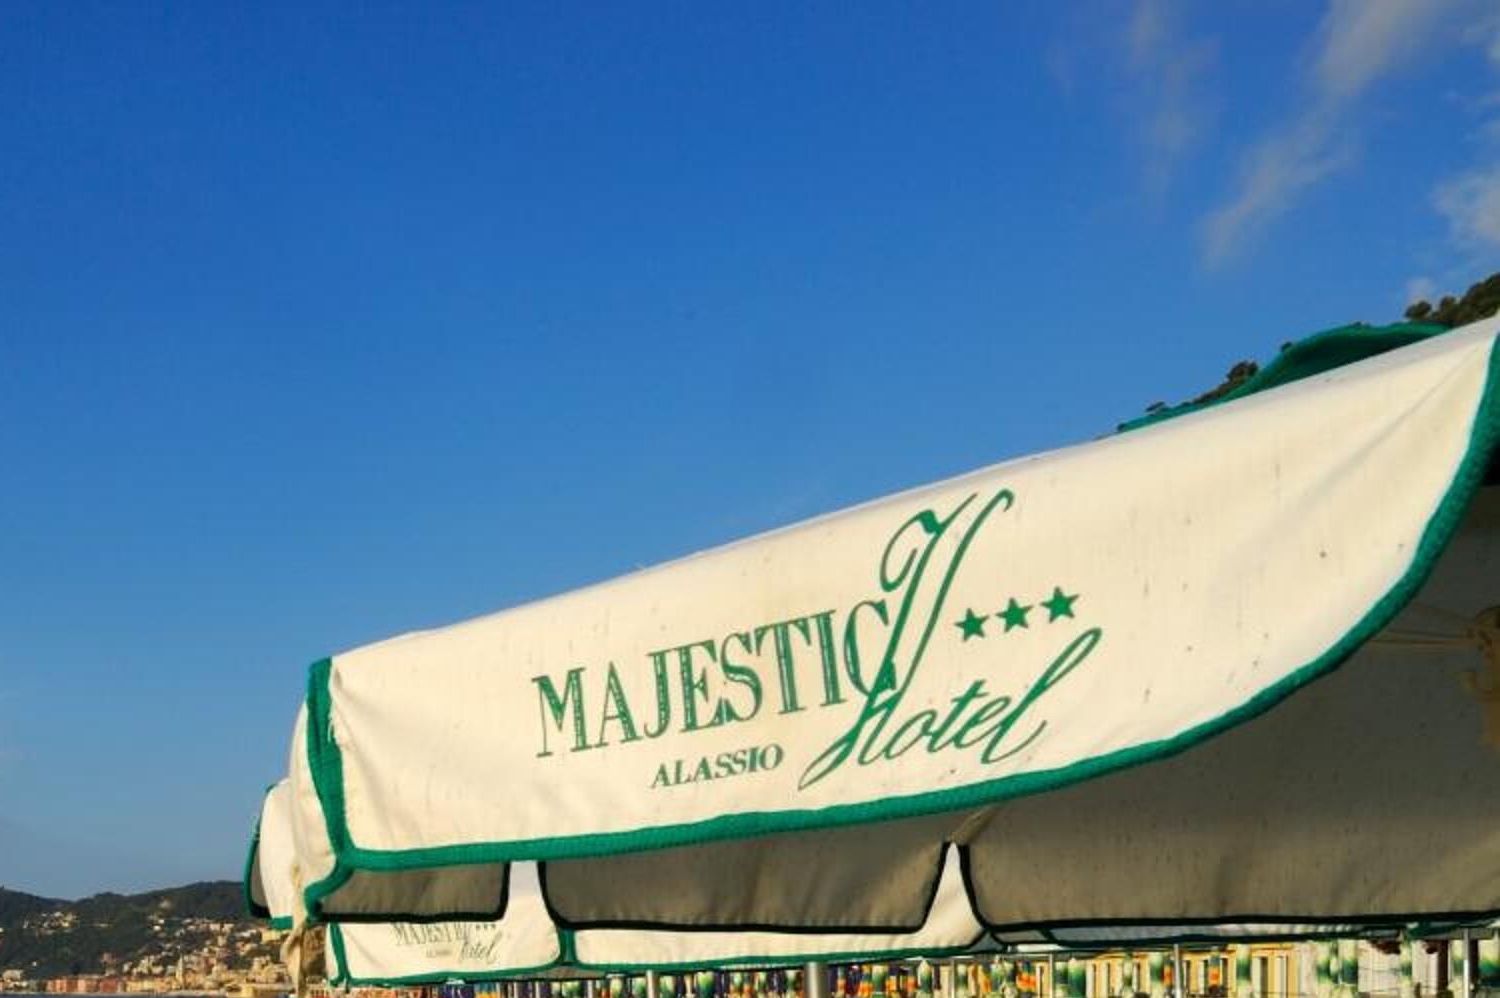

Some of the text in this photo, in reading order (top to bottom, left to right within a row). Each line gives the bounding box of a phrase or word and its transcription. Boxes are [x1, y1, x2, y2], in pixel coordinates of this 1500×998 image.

[532, 598, 892, 758] MAJESTIC
[798, 488, 1103, 791] Hotel
[650, 742, 785, 788] ALASSIO
